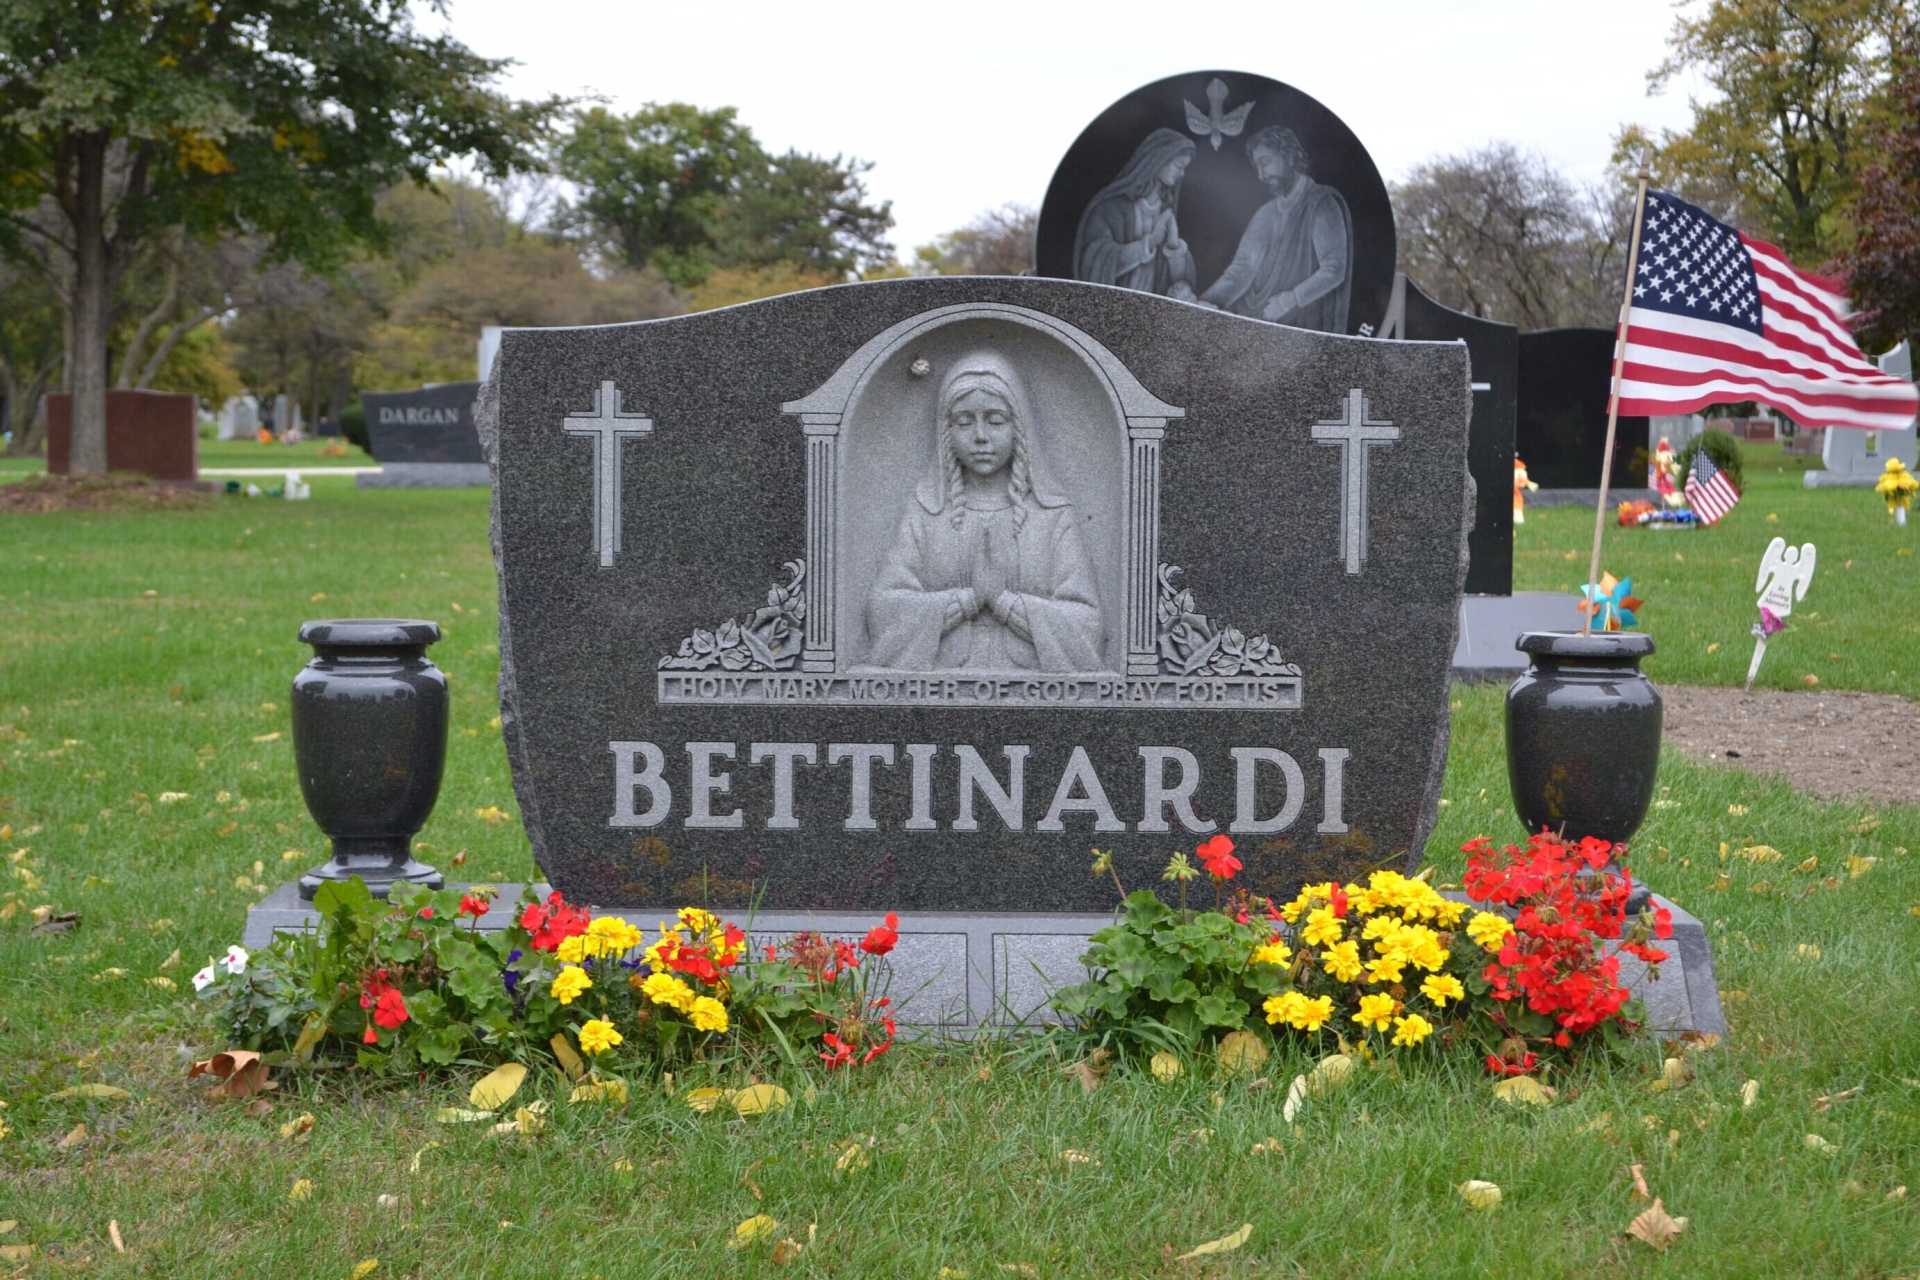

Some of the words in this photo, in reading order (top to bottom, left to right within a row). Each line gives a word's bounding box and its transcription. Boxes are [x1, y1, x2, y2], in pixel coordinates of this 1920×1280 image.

[379, 406, 460, 425] DARGAN
[681, 677, 747, 700] HOLY
[761, 677, 835, 700] MARY
[850, 678, 960, 701] MOTHER
[973, 680, 1010, 701] OF
[1022, 680, 1080, 702] GOD
[1099, 680, 1161, 702] PRAY
[1175, 681, 1227, 702] FOR
[1243, 682, 1281, 703] US
[607, 740, 1351, 836] BETTINARDI
